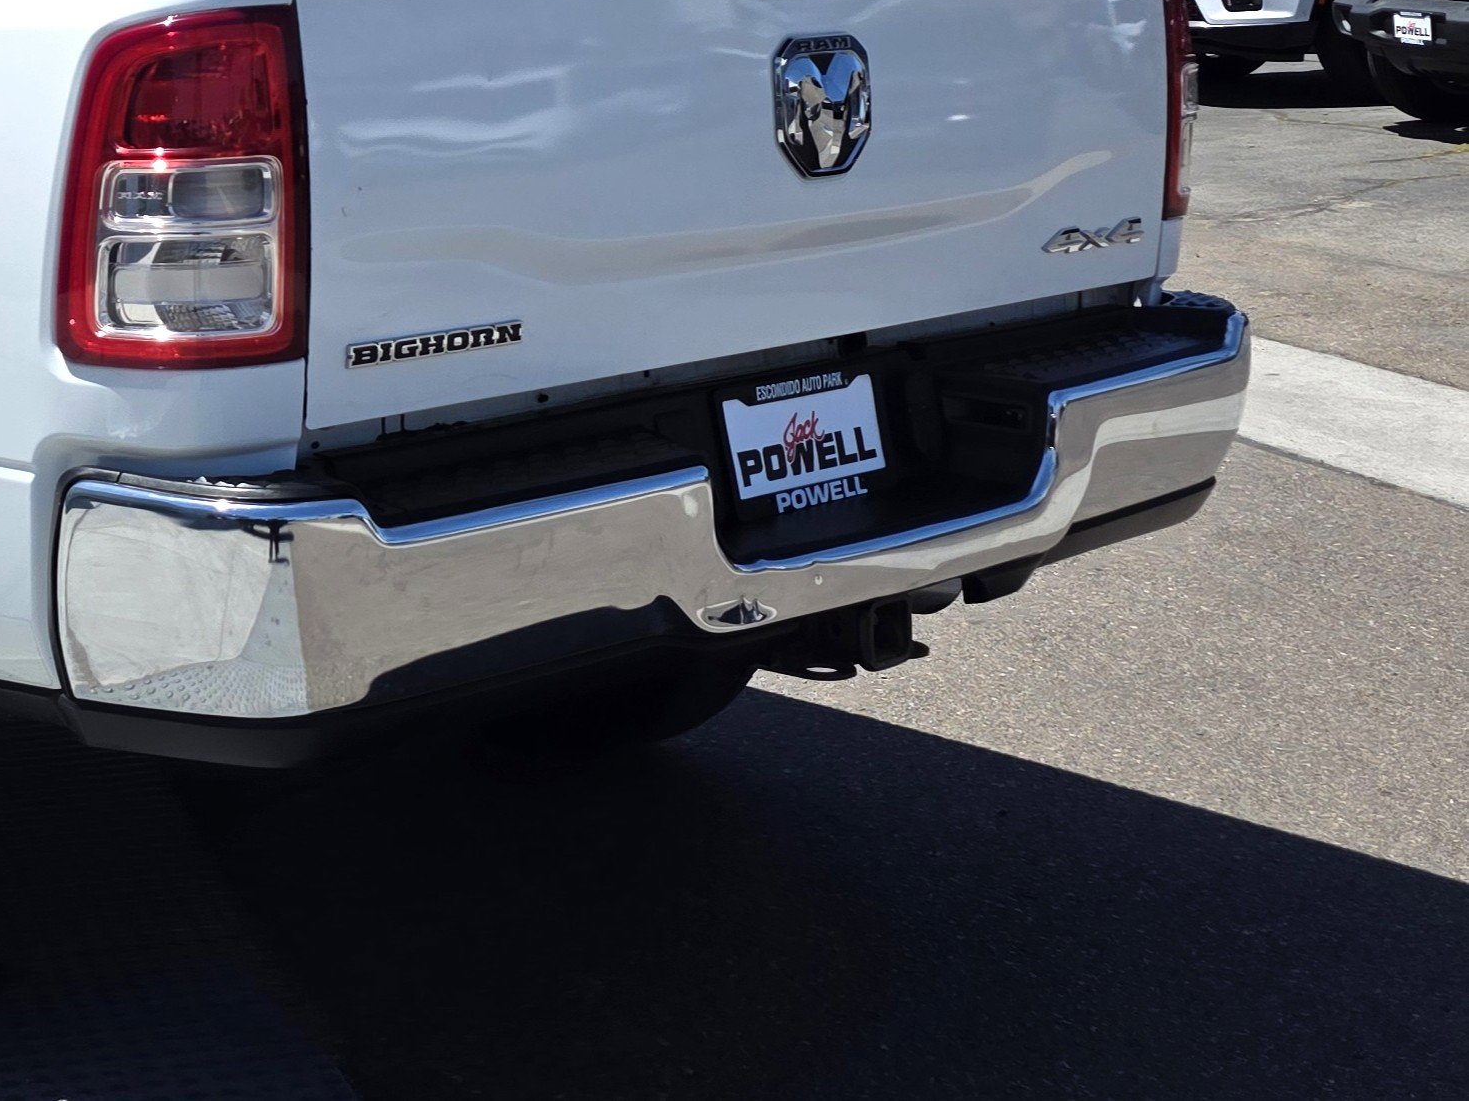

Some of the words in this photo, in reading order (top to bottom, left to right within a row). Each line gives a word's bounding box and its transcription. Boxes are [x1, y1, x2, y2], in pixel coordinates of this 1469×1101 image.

[798, 36, 851, 51] RAM
[348, 321, 523, 367] BIGHORN
[756, 378, 801, 401] ESCONDIDO
[802, 374, 822, 393] AUTO
[822, 371, 844, 390] PARK
[737, 426, 878, 488] POWELL
[783, 411, 825, 463] Jack
[775, 476, 869, 514] POWELL
